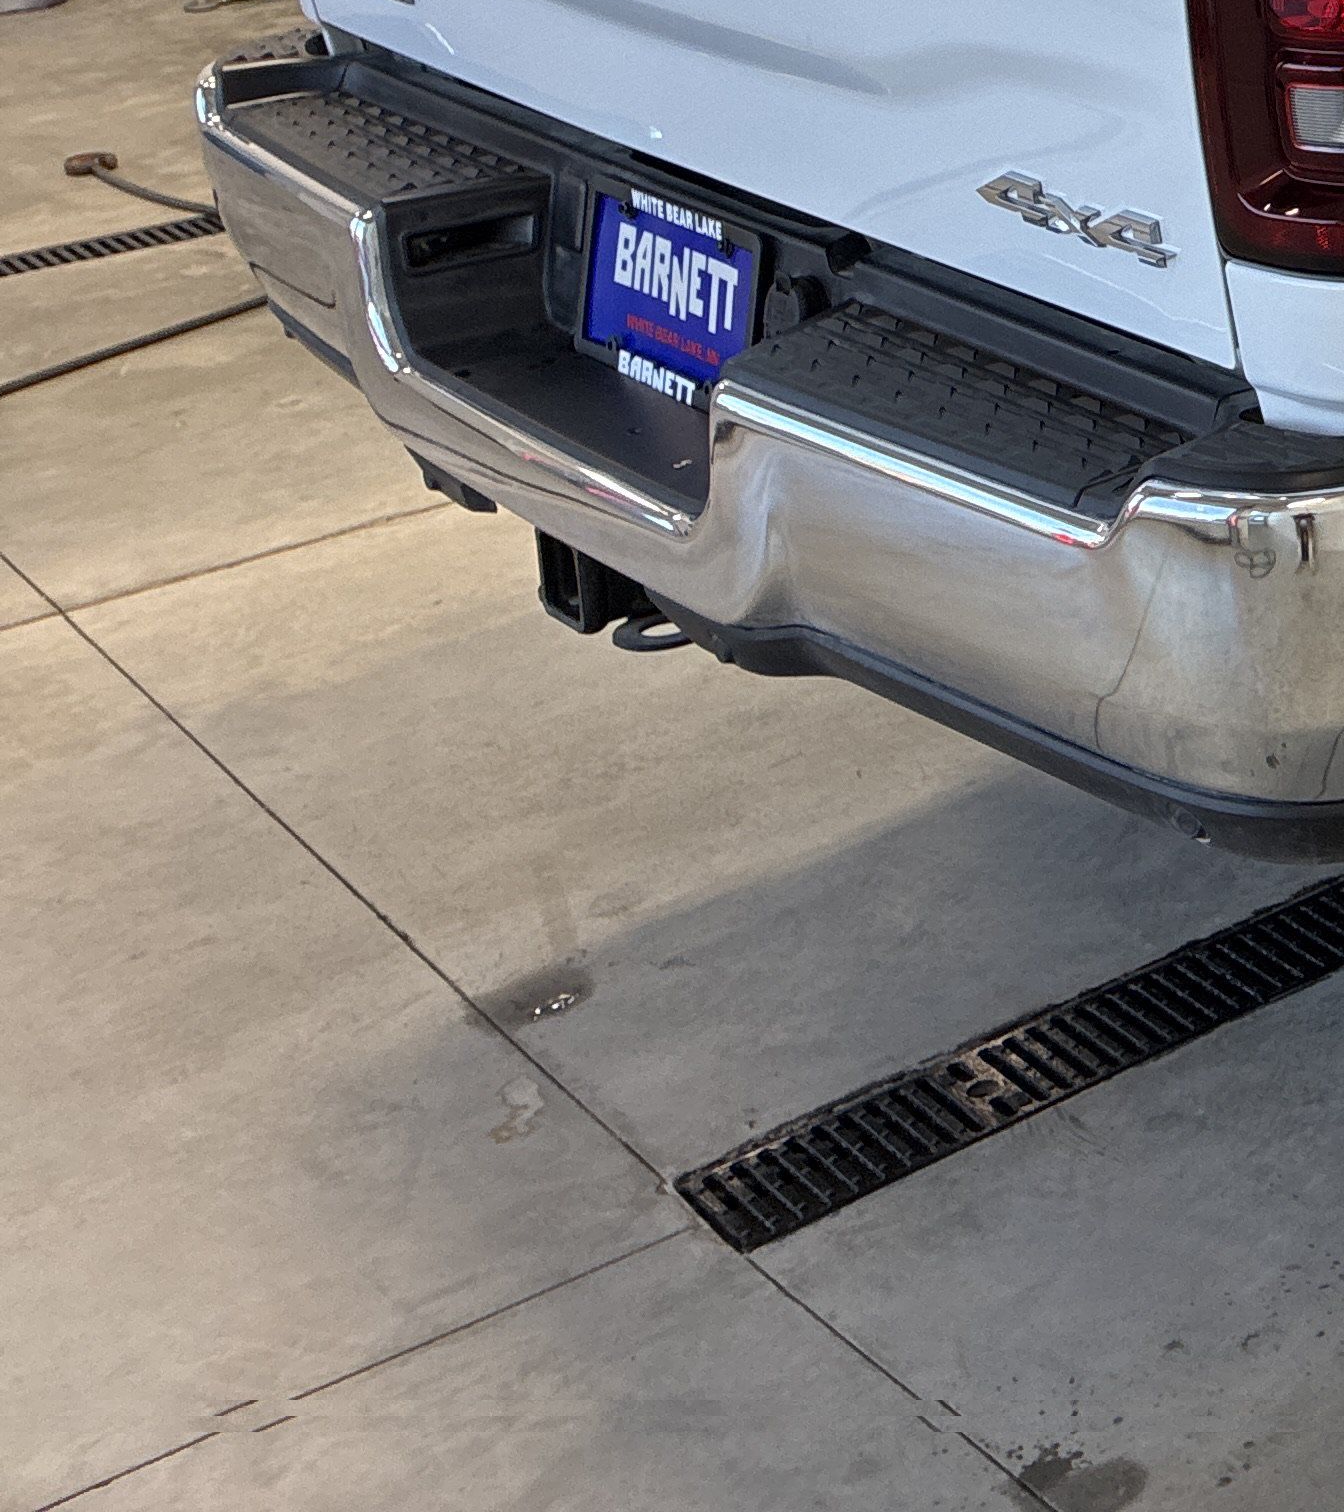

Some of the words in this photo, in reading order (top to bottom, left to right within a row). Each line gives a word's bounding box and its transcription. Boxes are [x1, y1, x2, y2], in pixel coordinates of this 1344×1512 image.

[631, 188, 665, 220] WHITE
[665, 201, 694, 231] BEAR
[694, 212, 723, 242] LAKE
[613, 221, 739, 335] BARNETT
[618, 349, 696, 406] BARNETT
